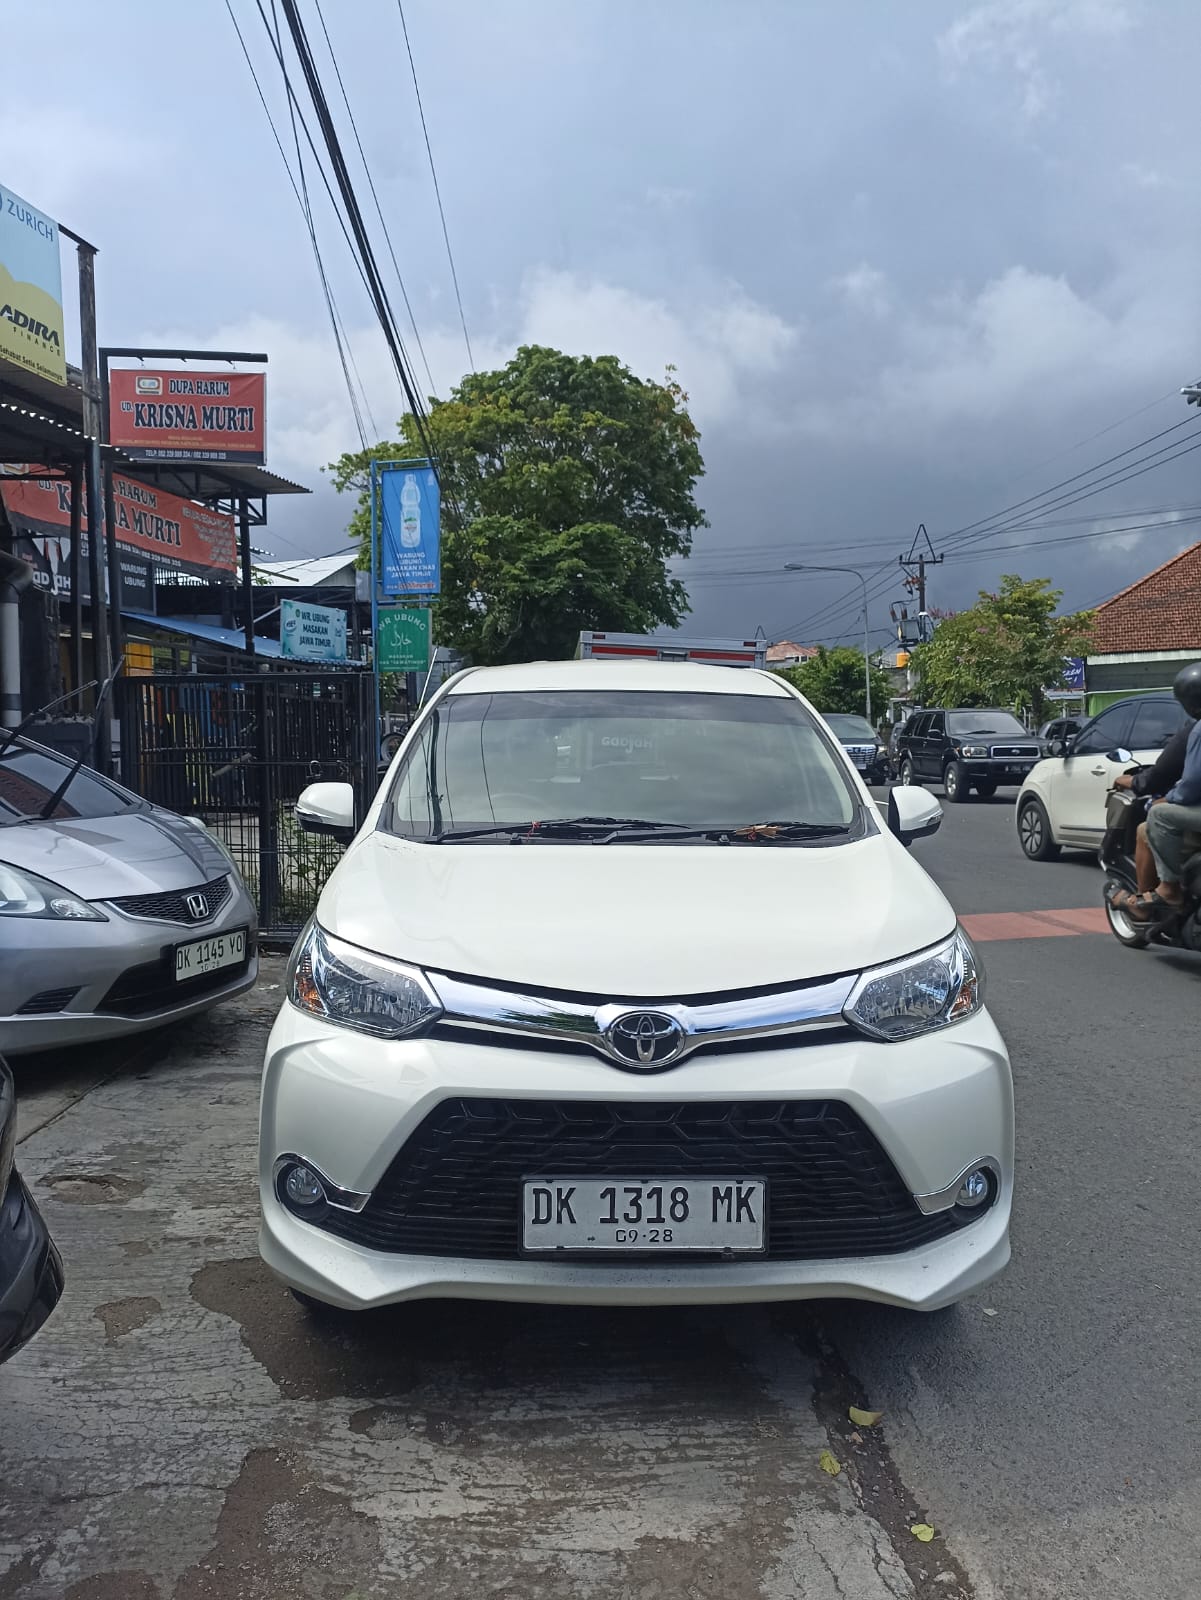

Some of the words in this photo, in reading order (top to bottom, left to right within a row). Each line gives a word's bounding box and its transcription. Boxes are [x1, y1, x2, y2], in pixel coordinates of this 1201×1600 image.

[7, 199, 54, 242] ZURICH
[0, 304, 60, 347] ADIRA
[13, 326, 61, 357] FINANCE
[22, 356, 35, 368] Setia
[169, 379, 196, 395] DUPA
[196, 380, 230, 396] HARUM
[134, 402, 198, 430] KRISNA
[201, 404, 255, 432] MURTI
[118, 480, 157, 509] HARUM
[131, 506, 182, 547] MURTI
[120, 562, 147, 576] WARUNG
[124, 576, 146, 589] UBUNG
[302, 623, 329, 636] MASAKAN
[312, 612, 330, 624] UBUNG
[379, 617, 391, 630] WR
[393, 613, 426, 631] UBUNG
[299, 635, 315, 646] JAWA
[176, 948, 191, 970] DK
[196, 939, 224, 965] 1145
[531, 1187, 577, 1224] DK
[599, 1186, 690, 1224] 1318
[711, 1186, 757, 1223] MK
